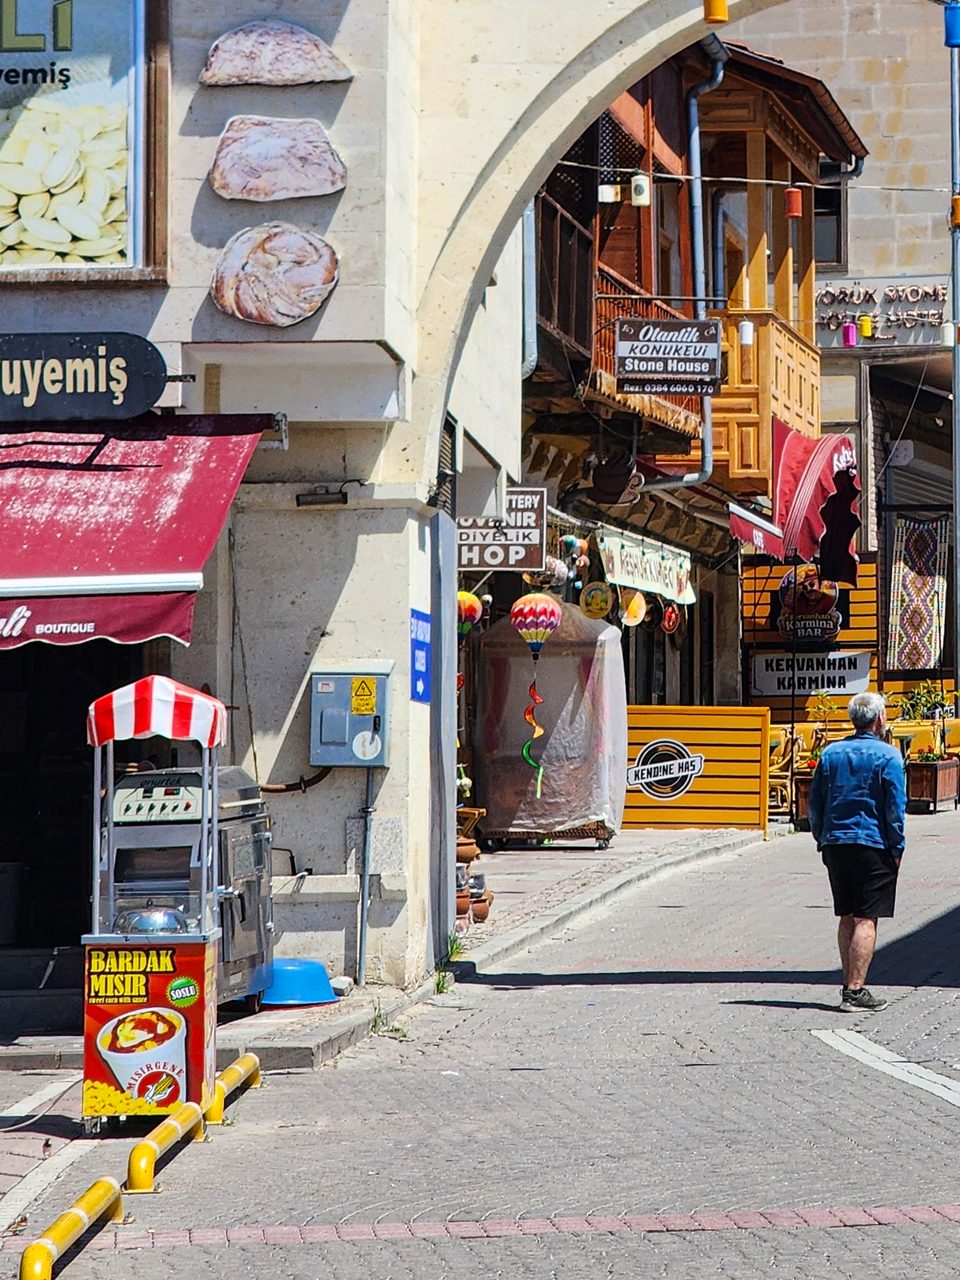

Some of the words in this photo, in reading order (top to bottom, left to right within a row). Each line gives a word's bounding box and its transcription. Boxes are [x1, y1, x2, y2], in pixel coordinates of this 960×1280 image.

[625, 358, 664, 371] Stone
[667, 359, 710, 372] House
[797, 628, 822, 637] BAR
[765, 657, 858, 672] KERVANHAN
[777, 674, 847, 690] KARMİNA
[677, 760, 696, 774] HAS
[90, 950, 174, 973] BARDAK
[90, 974, 147, 997] MISIR
[170, 985, 196, 1001] SOSLU
[127, 1061, 185, 1092] MISIRGENE
